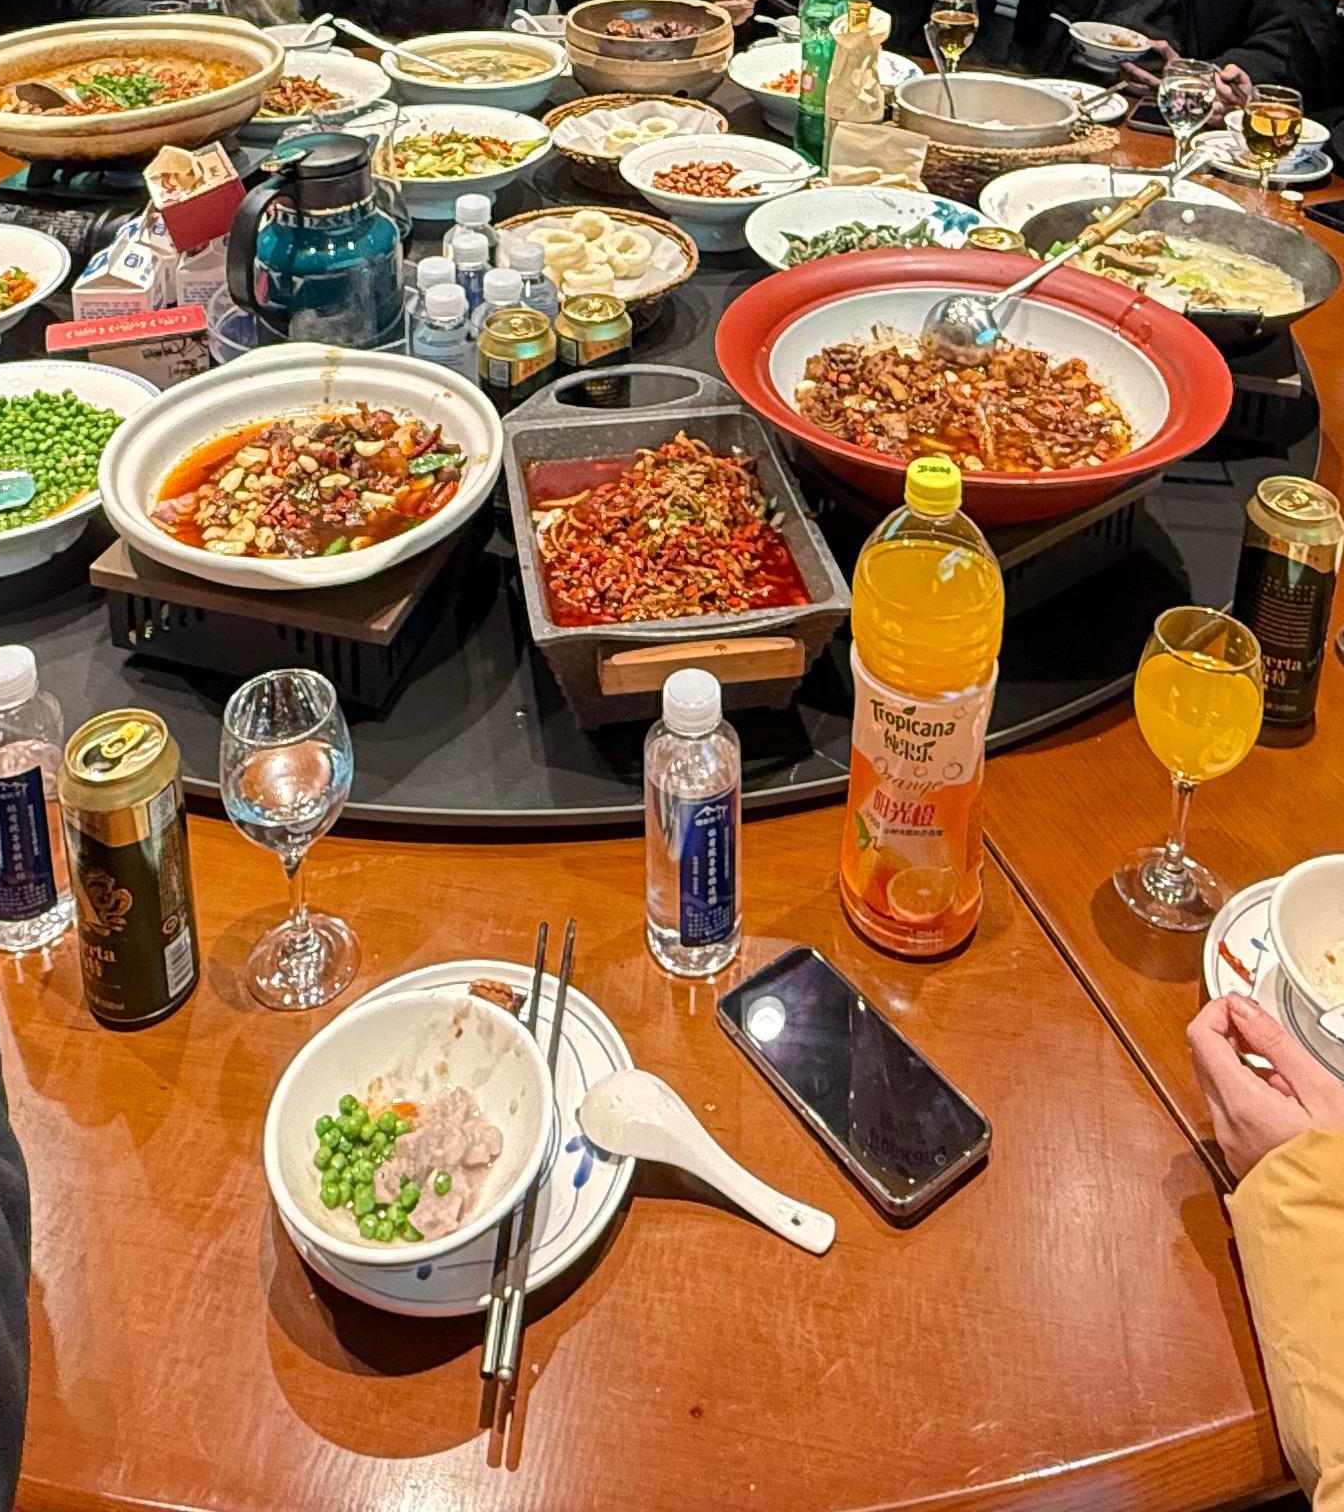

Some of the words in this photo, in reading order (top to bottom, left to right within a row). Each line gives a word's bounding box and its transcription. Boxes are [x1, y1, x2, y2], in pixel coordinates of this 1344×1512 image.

[870, 699, 956, 737] Tropicana
[873, 789, 936, 827] 阳光橙
